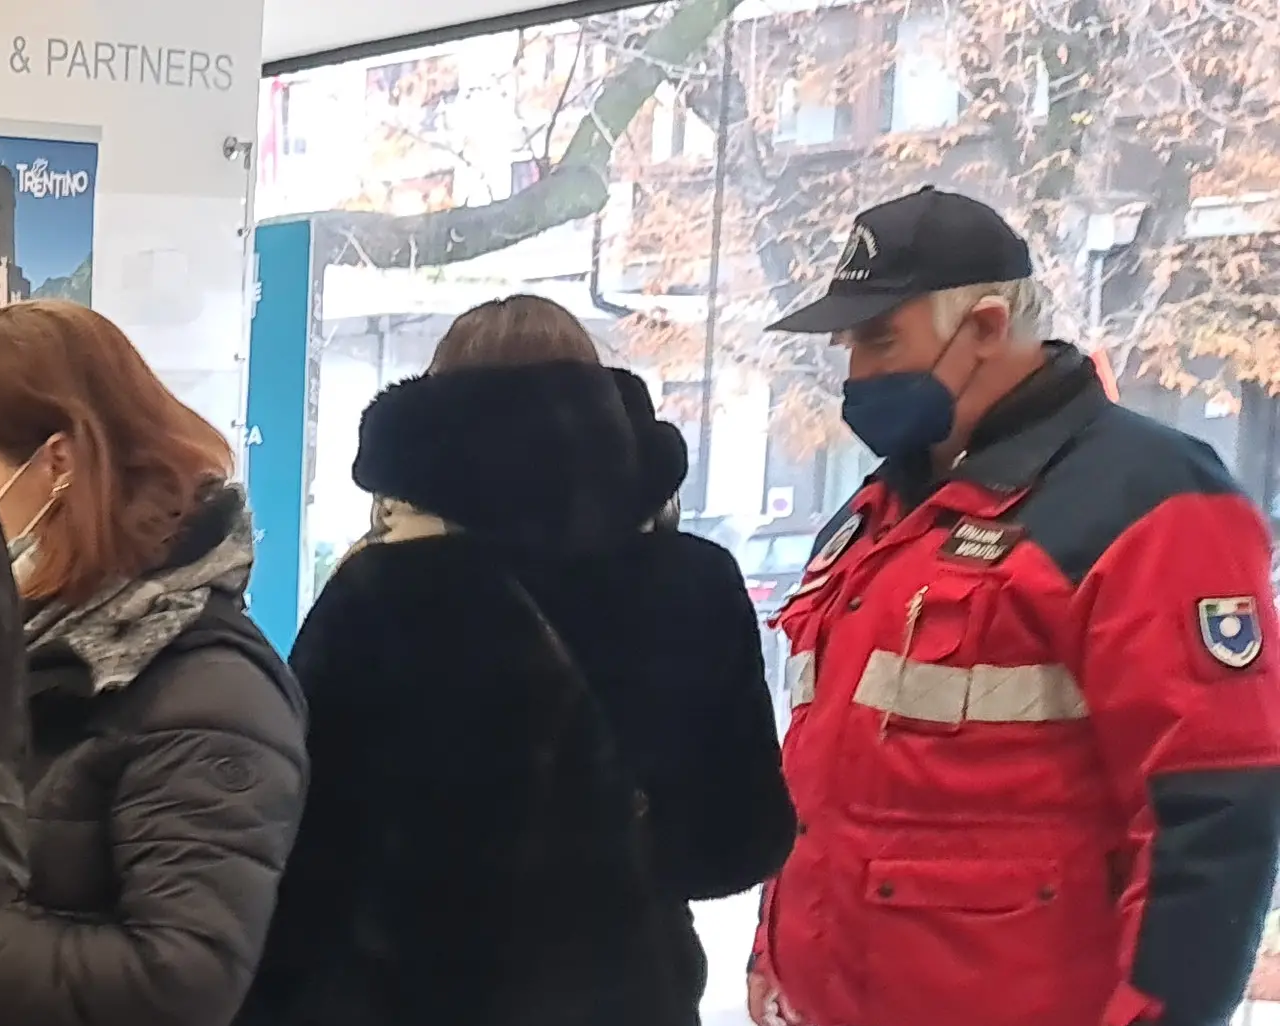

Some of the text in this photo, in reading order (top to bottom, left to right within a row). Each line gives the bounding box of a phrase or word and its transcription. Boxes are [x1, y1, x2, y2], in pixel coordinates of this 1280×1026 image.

[9, 38, 31, 74] &
[46, 38, 234, 91] PARTNERS
[16, 159, 89, 200] TRENTINO
